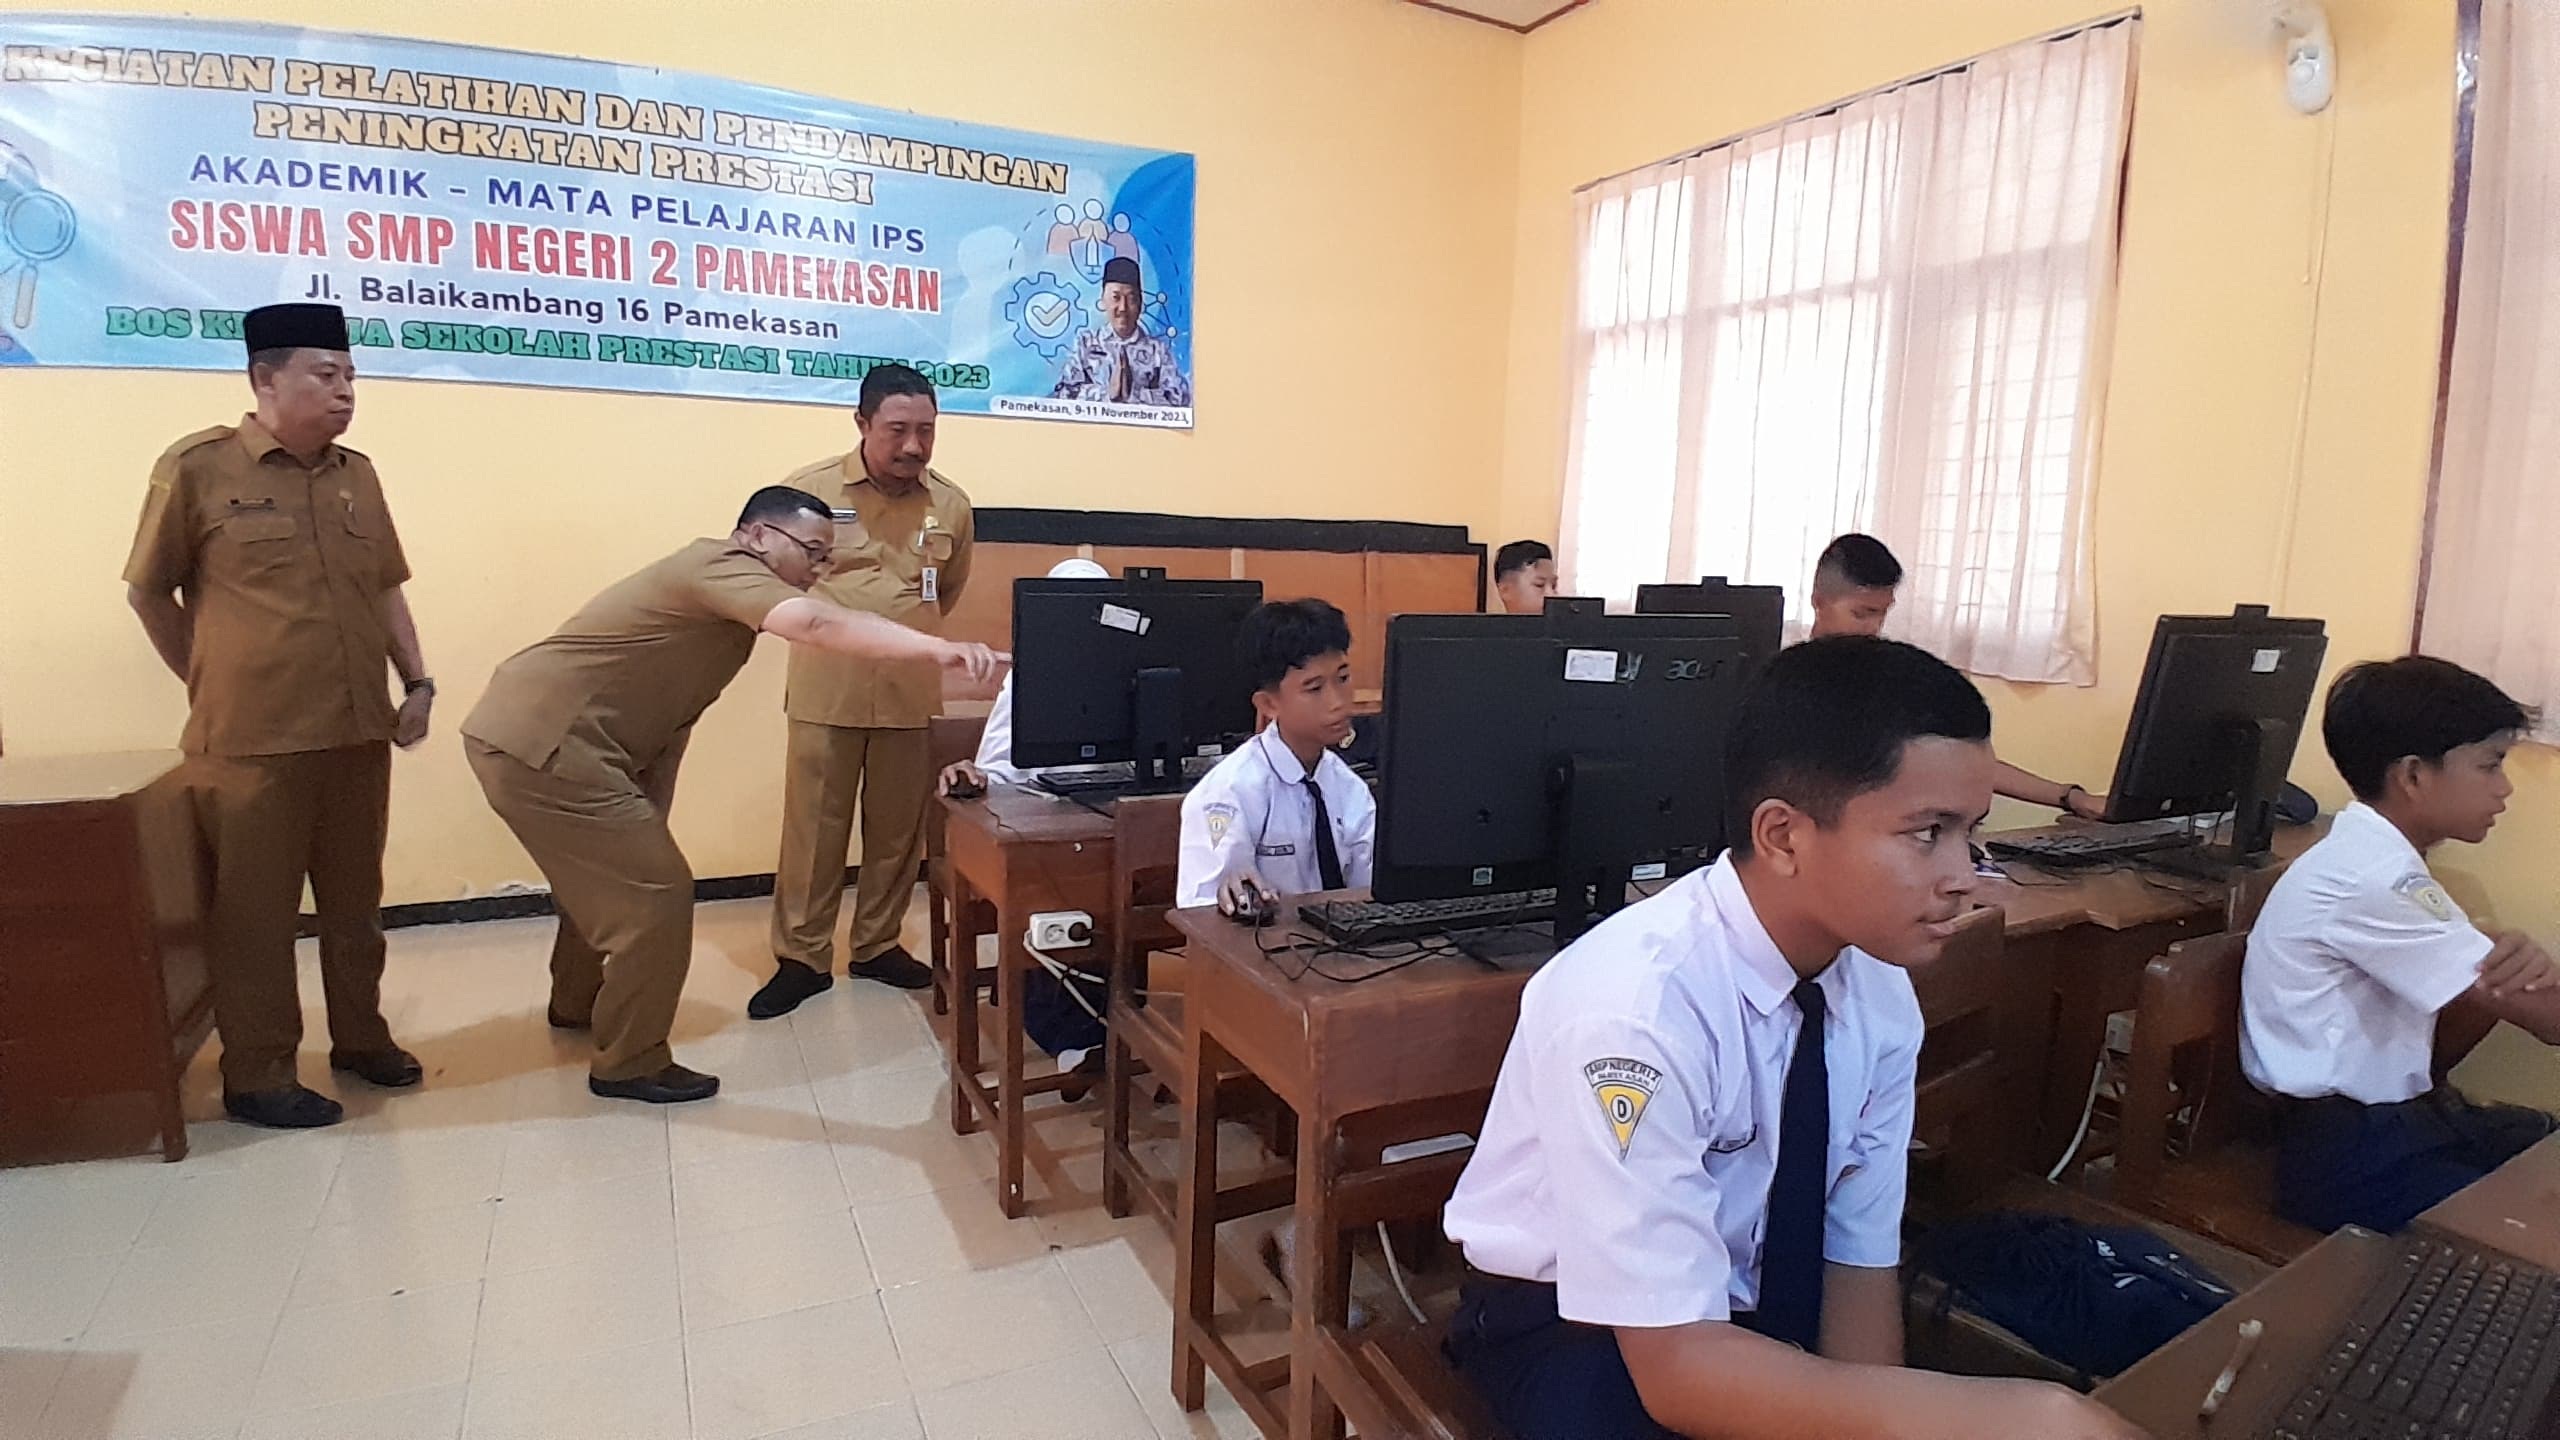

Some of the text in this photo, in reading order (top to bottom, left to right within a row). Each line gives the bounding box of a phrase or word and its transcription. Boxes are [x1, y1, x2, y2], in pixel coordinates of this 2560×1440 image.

[4, 44, 1069, 194] KEGIATAN PELATIHAN DAN PENDAMPINGAN
[254, 101, 874, 206] PENINGKATAN PRESTASI
[190, 155, 429, 199] AKADEMIK
[488, 178, 612, 218] MATA
[631, 195, 856, 246] PELAJARAN
[872, 224, 926, 254] IPS
[171, 199, 942, 313] SISWA SMP NEGERI 2 PAMEKASAN
[106, 306, 192, 338] BOS
[401, 320, 589, 361] SEKOLAH
[599, 334, 779, 374] PRESTASI
[916, 360, 990, 390] 2023
[305, 274, 839, 340] Jl. Balaikambang 16 Pamekasan
[1000, 399, 1072, 416] Pamekasan,
[1075, 405, 1097, 416] 9-11
[1101, 407, 1158, 420] November
[1617, 1099, 1627, 1119] D
